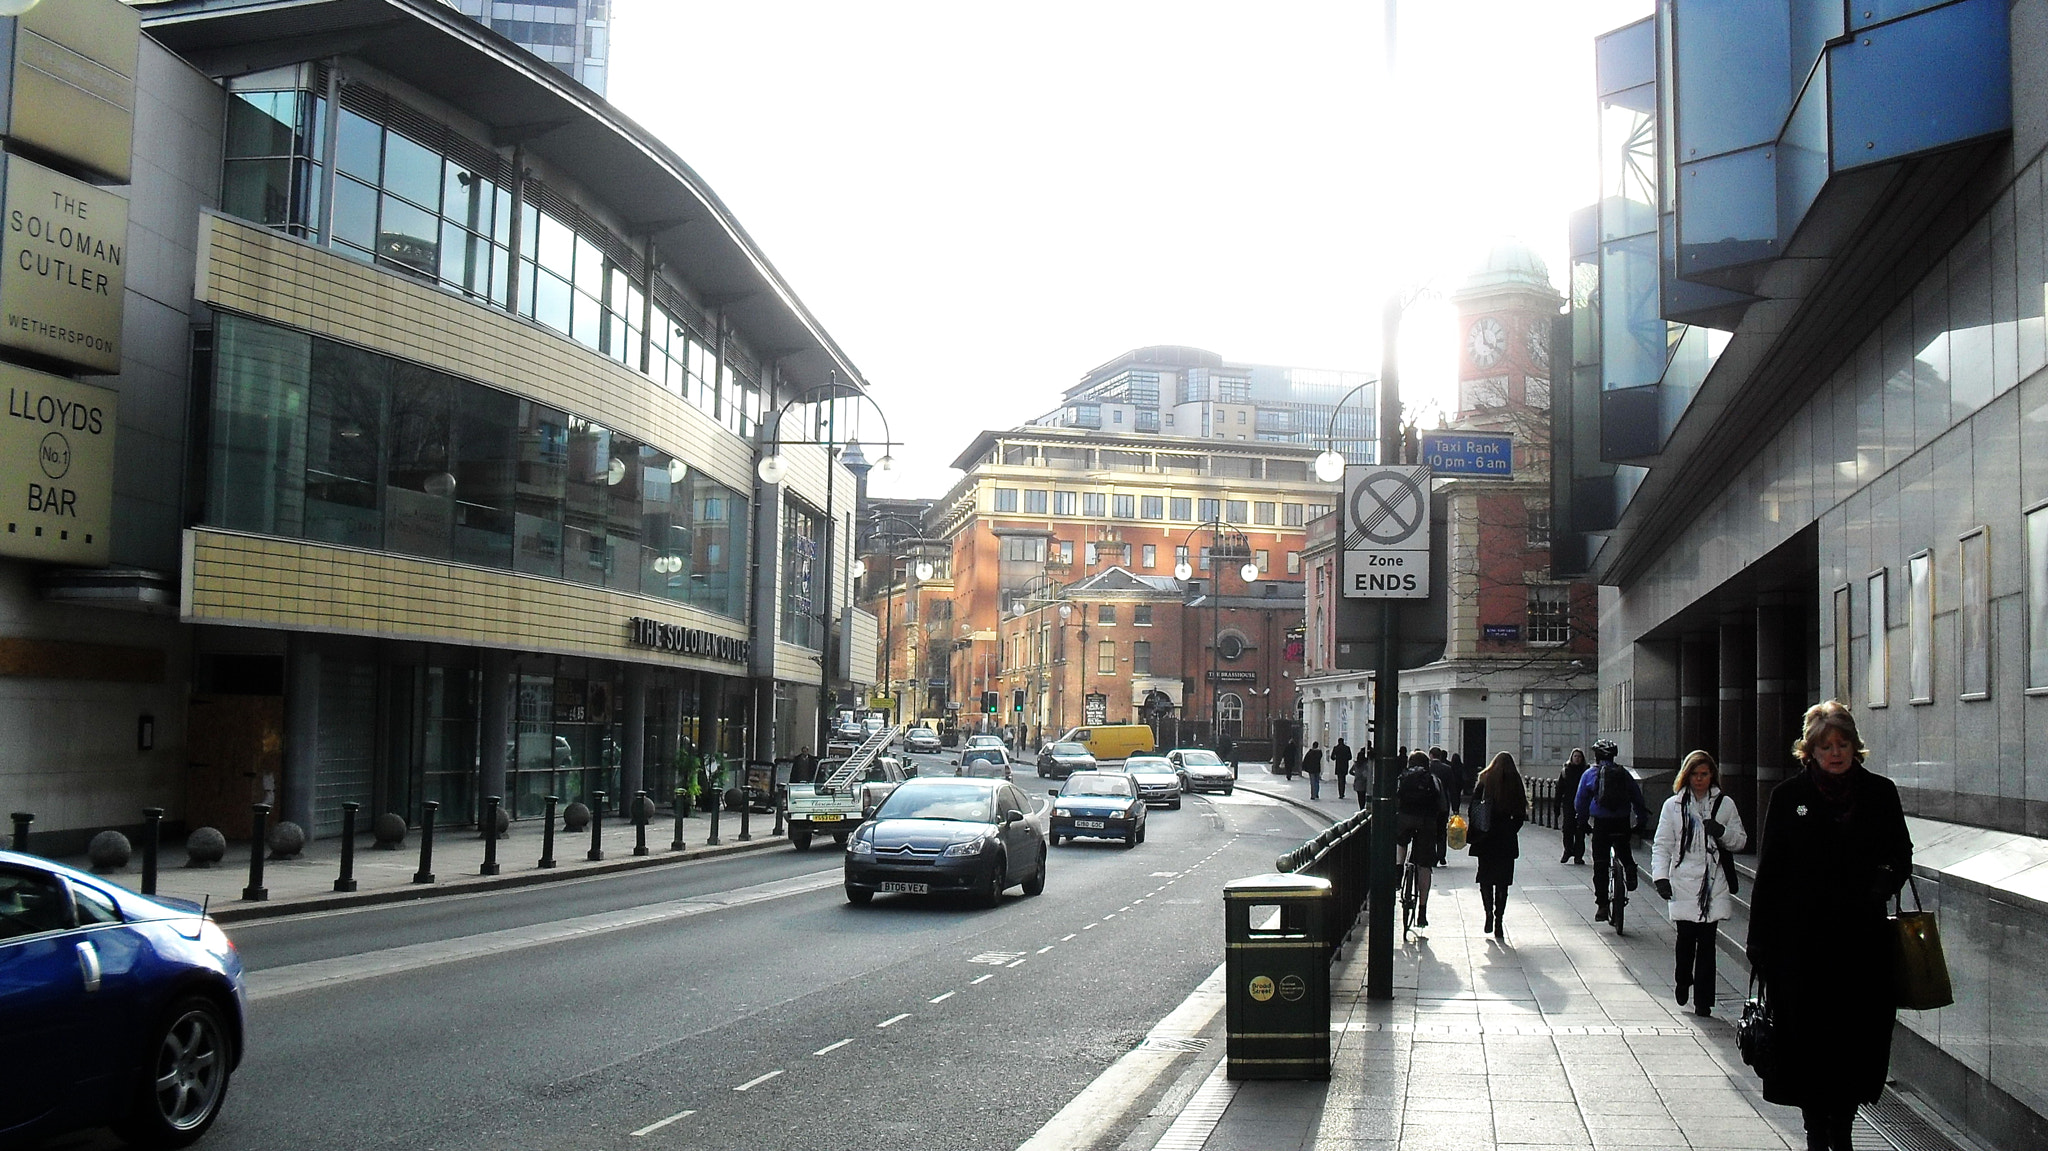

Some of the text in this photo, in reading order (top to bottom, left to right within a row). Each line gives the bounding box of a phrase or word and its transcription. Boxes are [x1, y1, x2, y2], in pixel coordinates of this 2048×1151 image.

[52, 191, 88, 220] THE
[10, 210, 122, 266] SOLOMAN
[18, 249, 109, 296] CUTLER
[8, 313, 113, 353] WETHERSPOON
[8, 387, 103, 435] LLOYDS
[1427, 455, 1441, 467] 10
[1445, 458, 1465, 470] pm
[1475, 456, 1483, 468] 6
[1486, 459, 1506, 469] am
[1434, 440, 1500, 454] Taxi Rank
[28, 483, 77, 517] BAR
[1368, 554, 1404, 567] Zone
[1355, 573, 1417, 591] ENDS
[637, 617, 663, 647] THE
[666, 624, 718, 658] SOLOMAN
[884, 882, 924, 892] BT06 VEX
